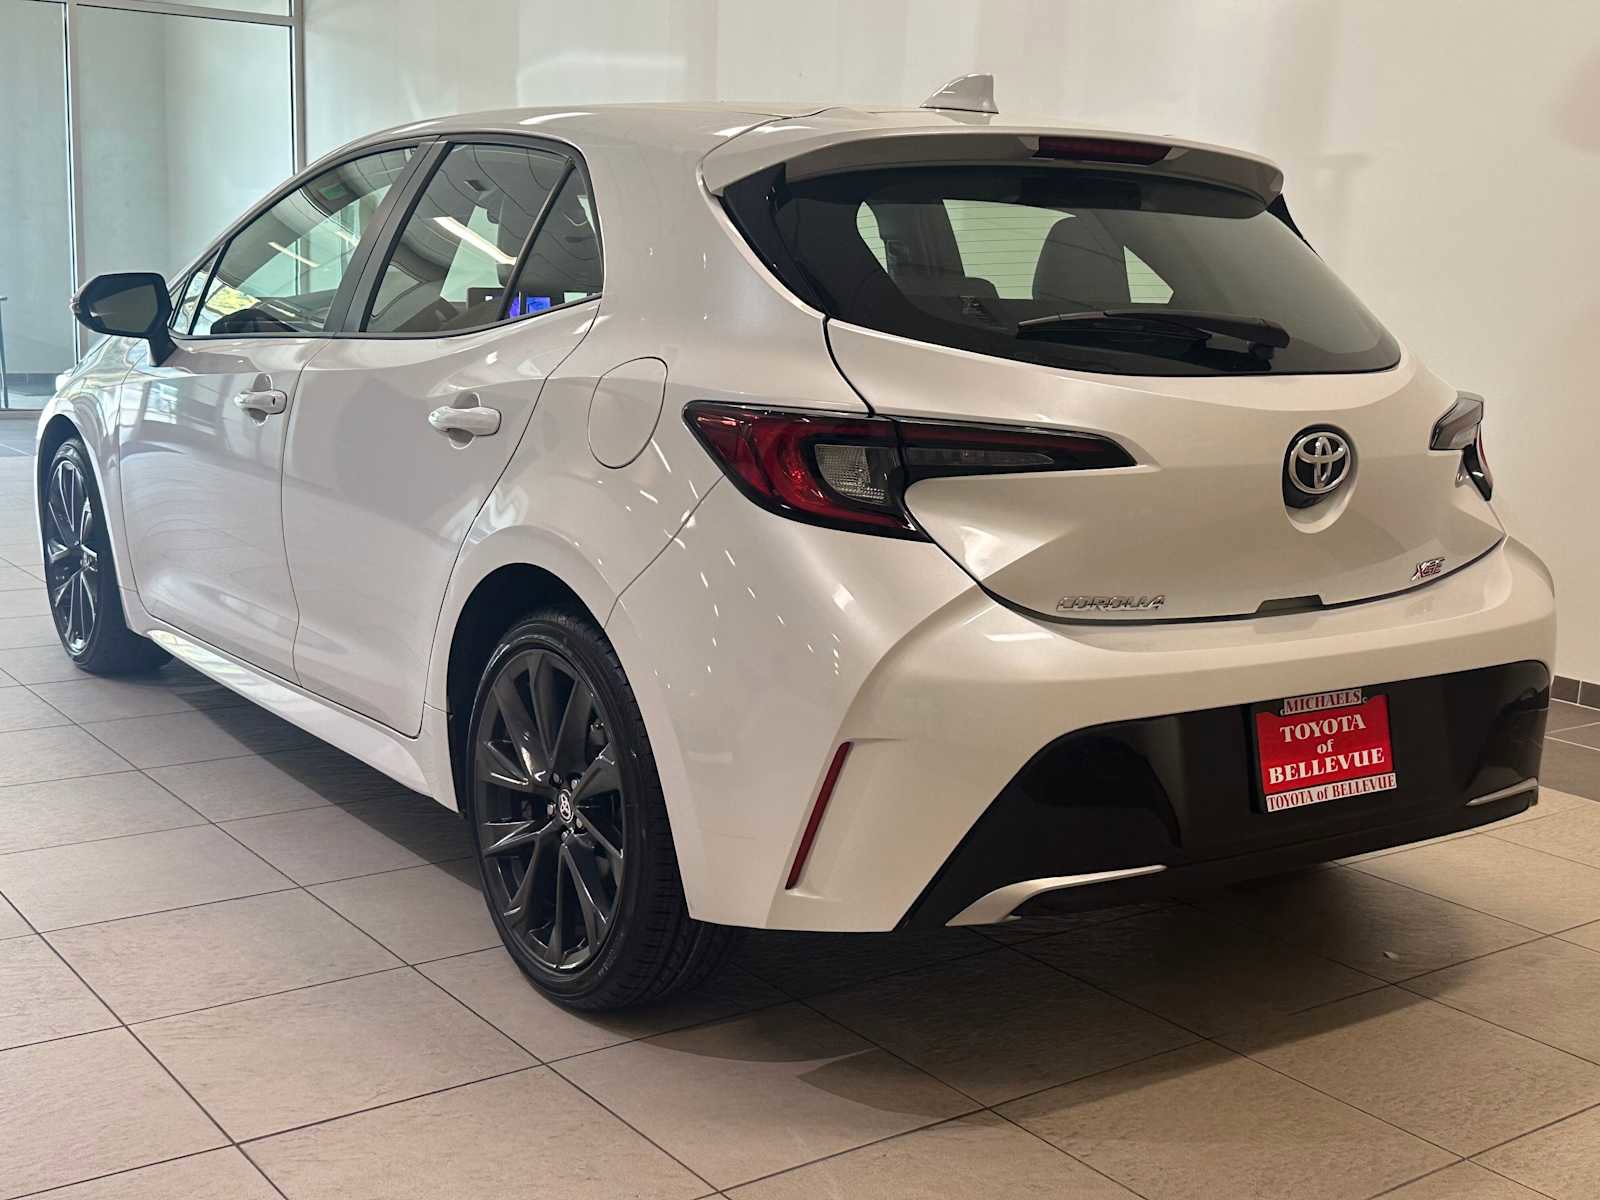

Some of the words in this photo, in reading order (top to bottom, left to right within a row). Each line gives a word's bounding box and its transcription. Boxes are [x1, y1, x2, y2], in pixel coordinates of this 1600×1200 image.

[1056, 594, 1166, 612] COROLLA
[1285, 690, 1361, 713] MICHAELS
[1280, 714, 1366, 742] TOYOTA
[1317, 739, 1334, 754] of
[1269, 748, 1384, 784] BELLEVUE
[1267, 790, 1314, 810] TOYOTA
[1317, 786, 1329, 801] of
[1332, 774, 1396, 798] BELLEVUE
